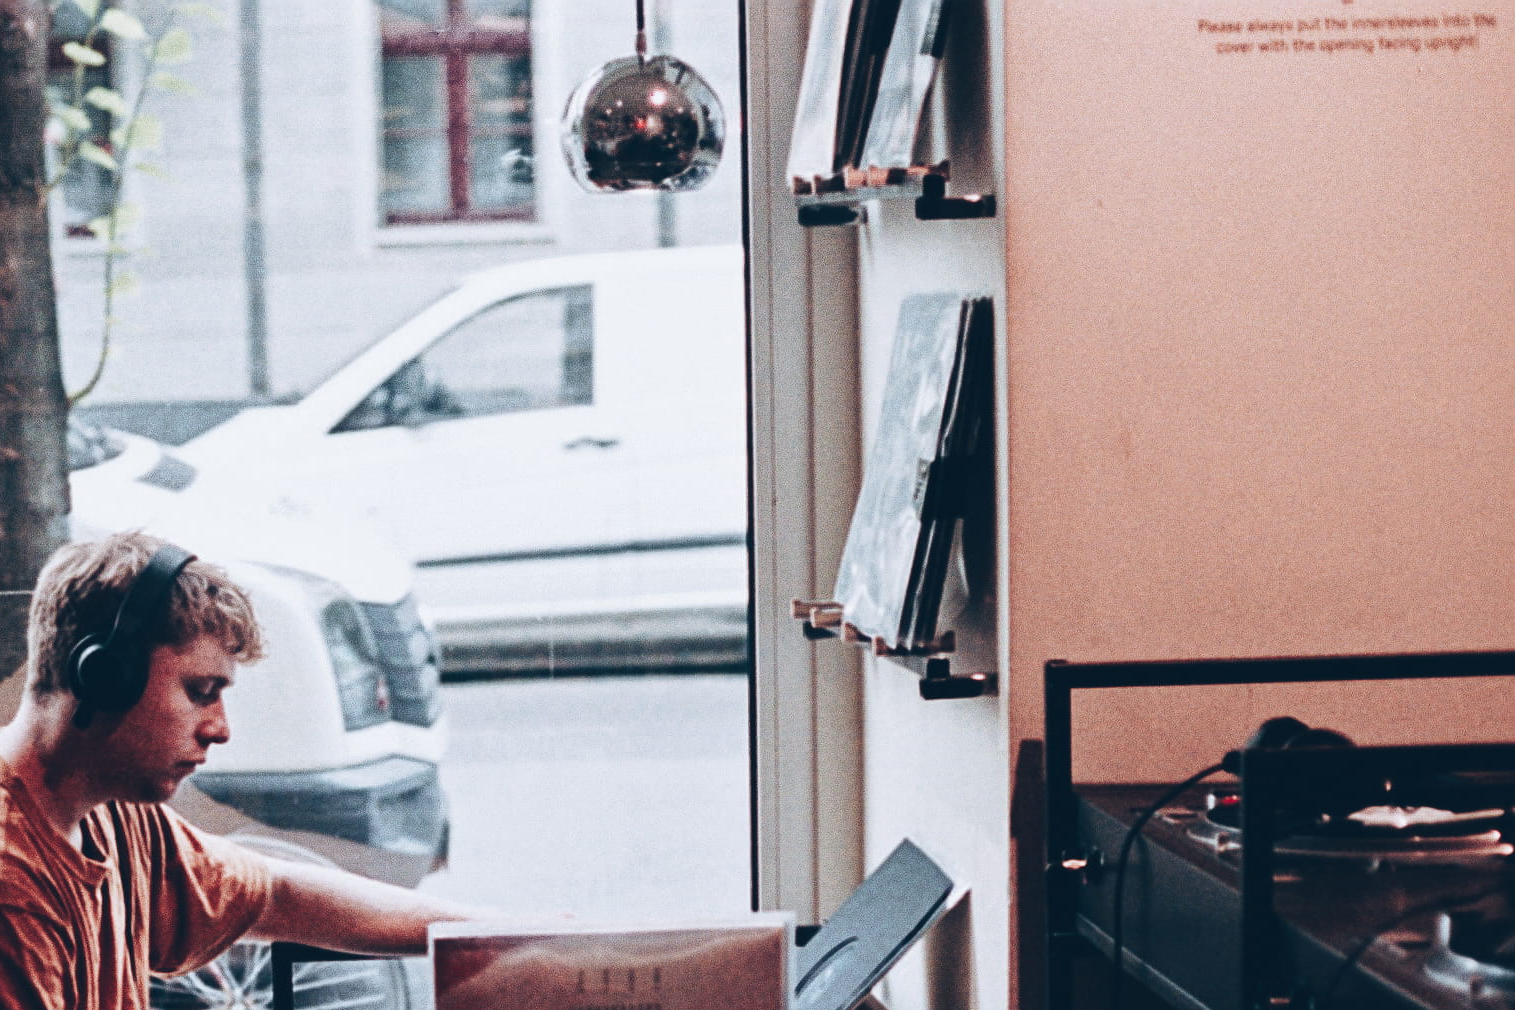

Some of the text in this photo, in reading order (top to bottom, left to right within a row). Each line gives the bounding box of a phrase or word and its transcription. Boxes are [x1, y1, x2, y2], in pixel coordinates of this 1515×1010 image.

[1197, 19, 1241, 34] Please
[1247, 19, 1293, 34] always
[1297, 18, 1320, 33] put
[1324, 18, 1348, 30] the
[1443, 15, 1470, 27] into
[1473, 14, 1497, 28] the
[1216, 43, 1253, 54] cover
[1258, 40, 1288, 52] with
[1292, 39, 1315, 52] the
[1319, 40, 1374, 54] opening
[1378, 37, 1421, 53] facing
